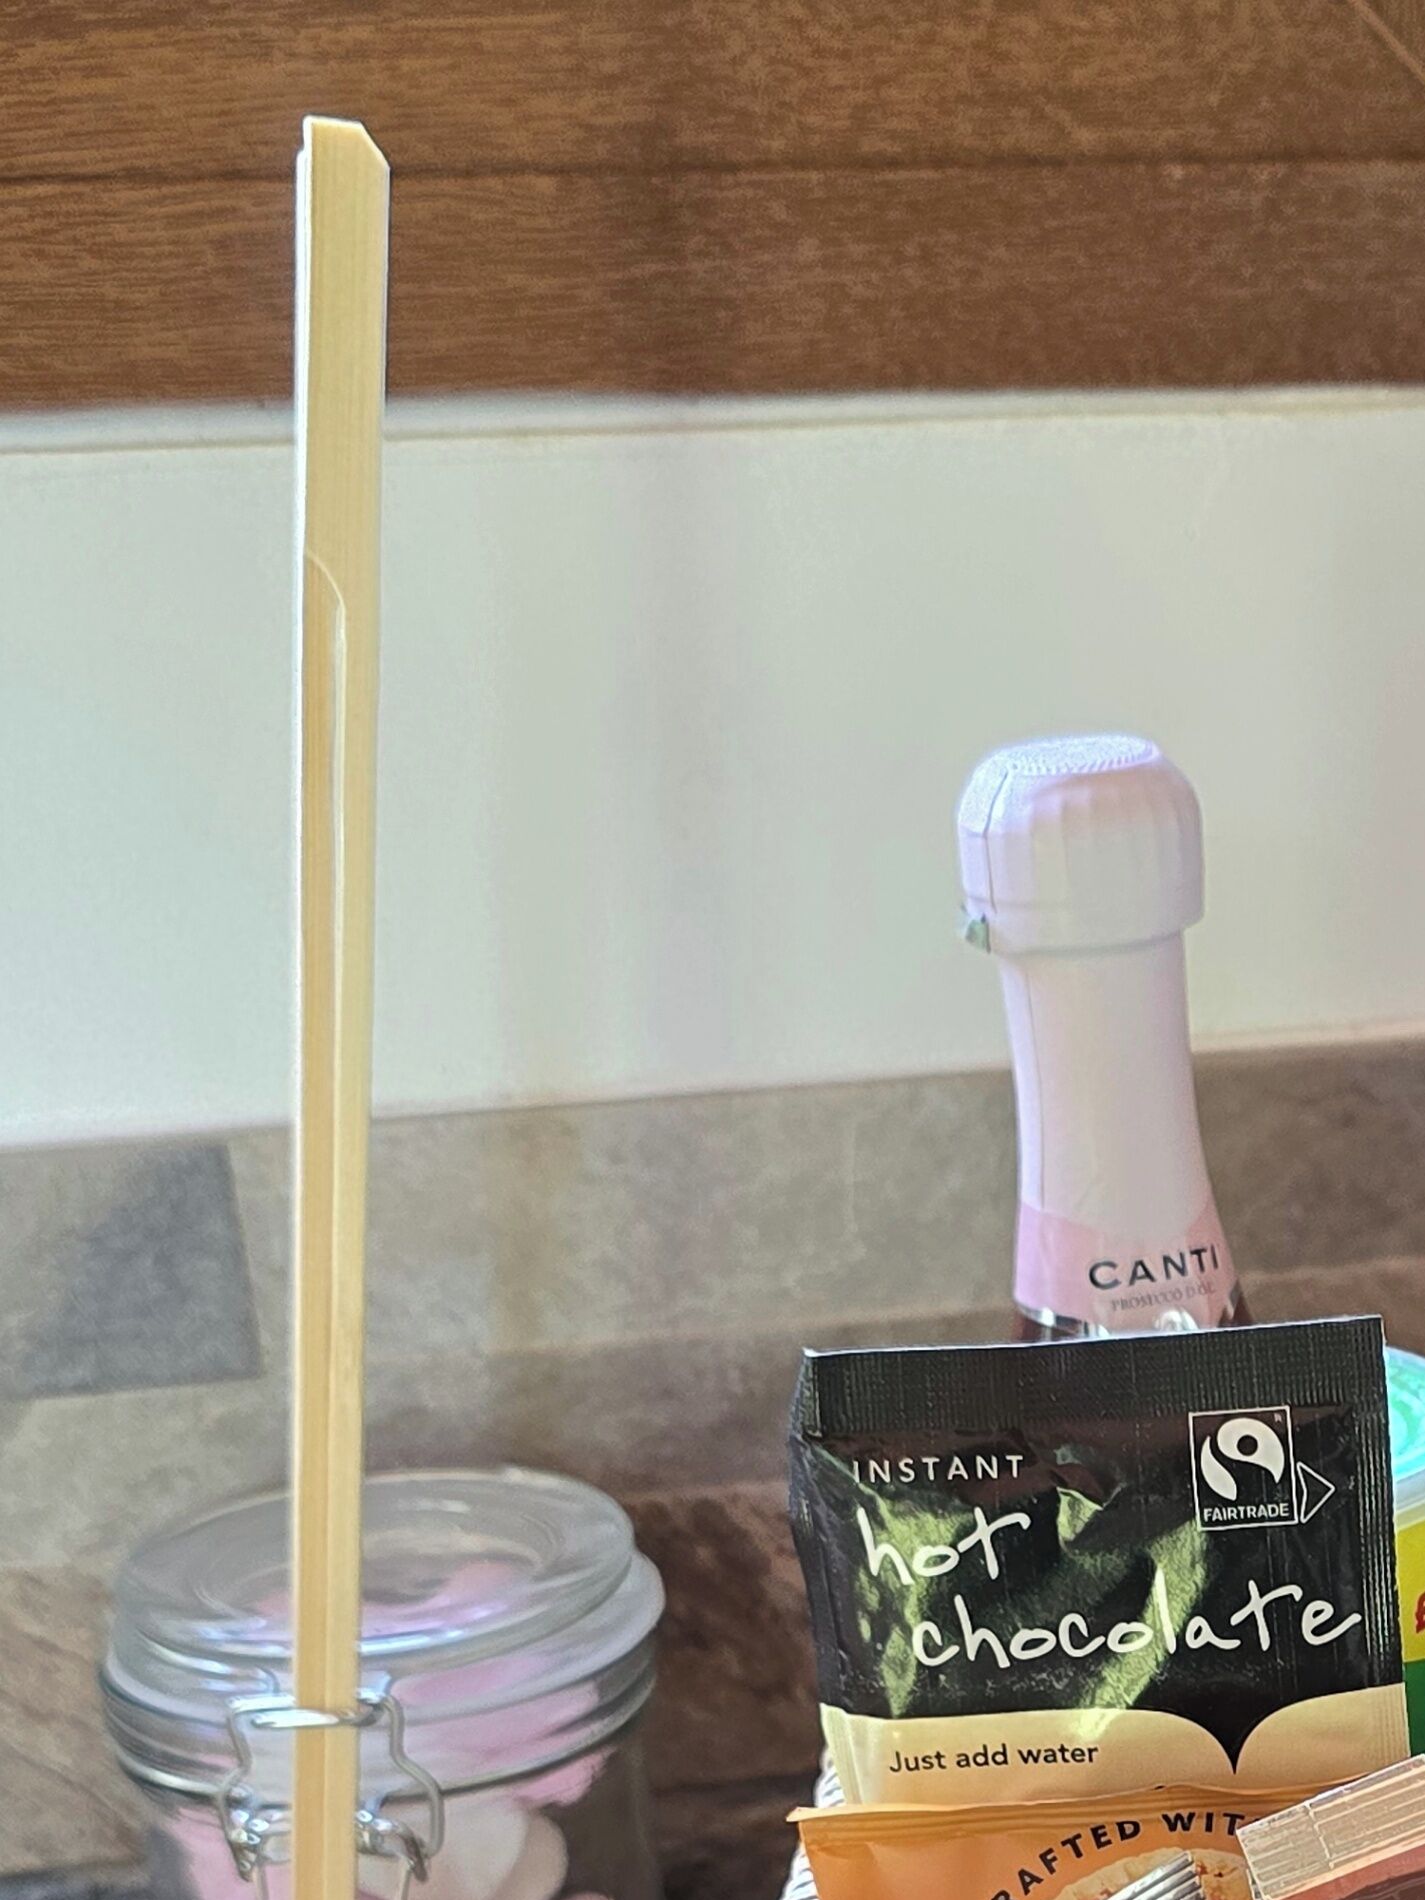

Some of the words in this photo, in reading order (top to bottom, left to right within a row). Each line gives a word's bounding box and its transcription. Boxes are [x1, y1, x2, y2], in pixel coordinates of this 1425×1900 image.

[1088, 1243, 1219, 1290] CANTI
[852, 1454, 1025, 1484] INSTANT
[1203, 1502, 1290, 1523] FAIRTRADE
[857, 1506, 1031, 1586] hot
[911, 1566, 1362, 1669] chocolate
[889, 1750, 947, 1773] Just
[955, 1743, 1009, 1768] add
[1017, 1743, 1099, 1765] water
[1161, 1811, 1260, 1837] WIT
